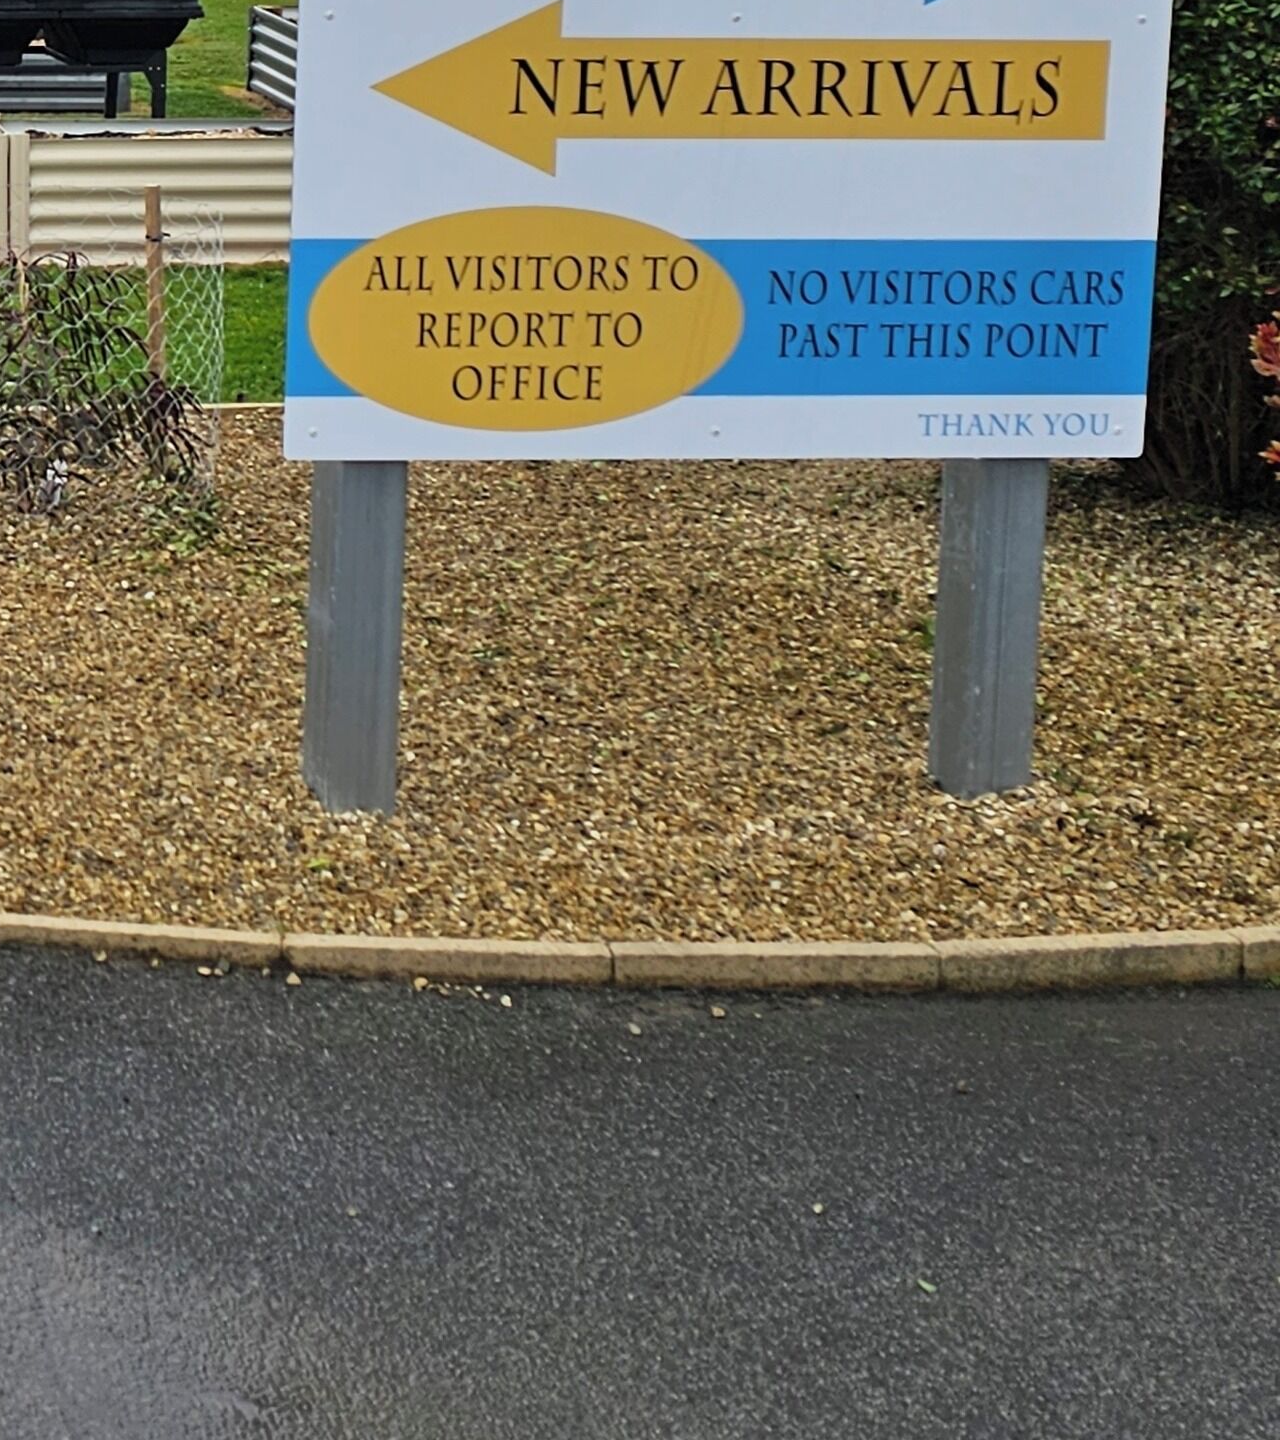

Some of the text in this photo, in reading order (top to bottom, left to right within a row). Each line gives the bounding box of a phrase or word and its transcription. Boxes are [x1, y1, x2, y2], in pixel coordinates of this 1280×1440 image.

[508, 55, 1063, 126] NEW ARRIVALS
[363, 253, 699, 296] ALL VISITORS TO
[768, 268, 1125, 308] NO VISITORS CARS
[415, 311, 643, 349] REPORT TO
[777, 322, 1109, 359] PAST THIS POINT
[451, 363, 603, 402] OFFICE
[918, 413, 1111, 439] THANK YOU
